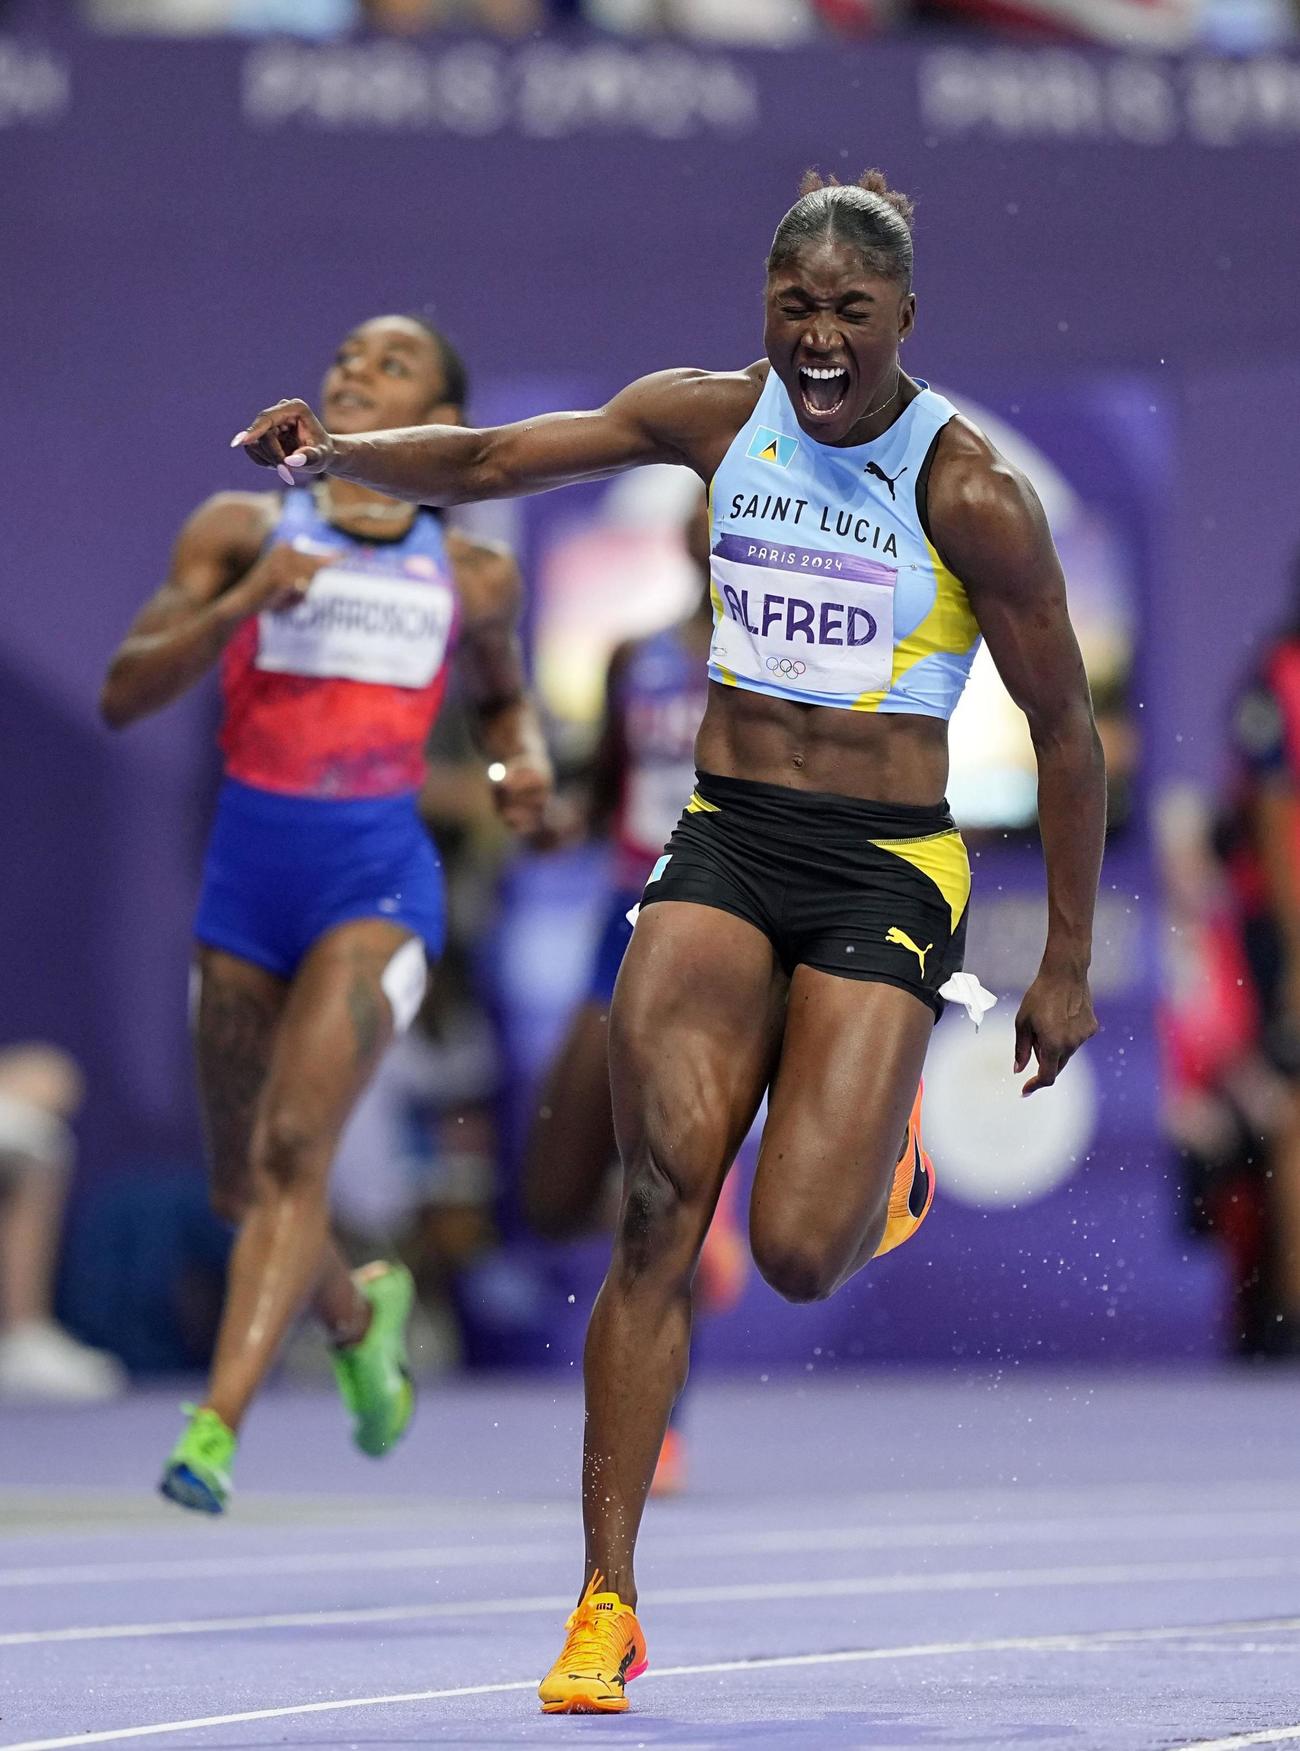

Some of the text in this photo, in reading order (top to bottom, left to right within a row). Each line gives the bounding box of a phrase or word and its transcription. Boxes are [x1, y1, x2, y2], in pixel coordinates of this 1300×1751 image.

[730, 494, 898, 558] SAINT LUCIA
[801, 555, 843, 571] 2024
[723, 584, 878, 647] ALFRED
